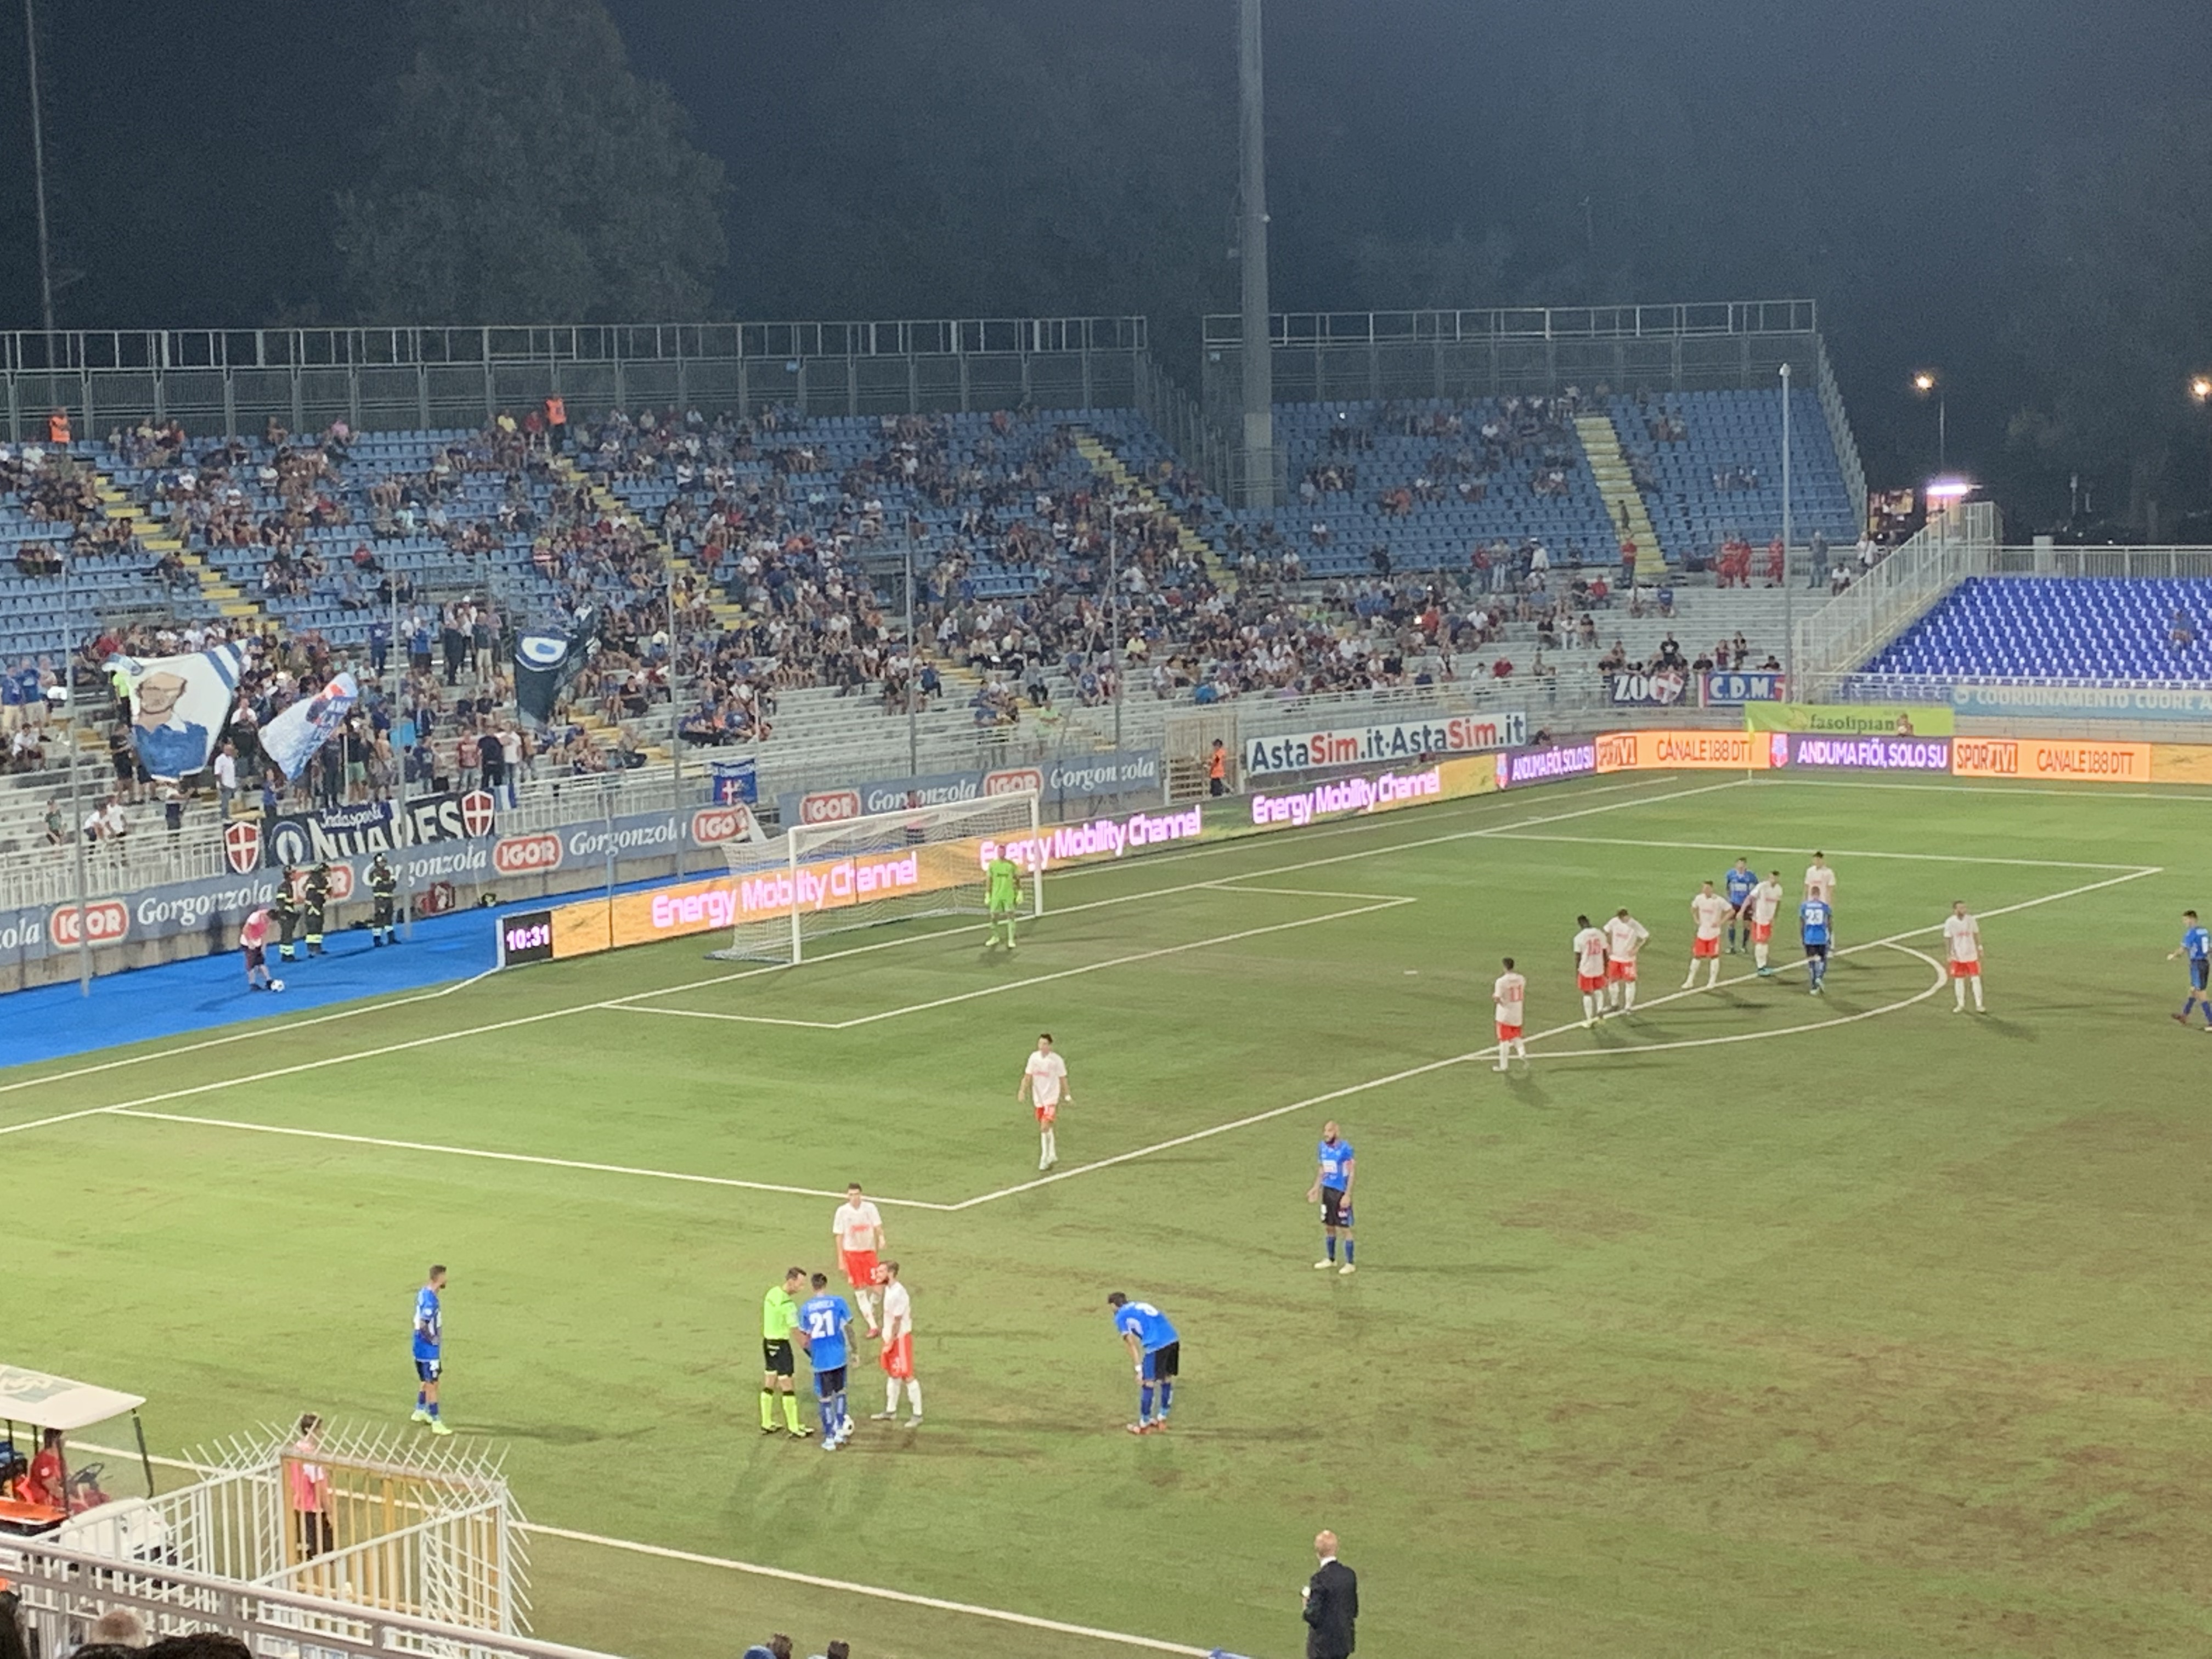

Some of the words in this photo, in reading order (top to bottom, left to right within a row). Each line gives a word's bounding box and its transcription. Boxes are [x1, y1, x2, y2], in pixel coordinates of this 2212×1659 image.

[1976, 689, 2129, 709] COORDINAMENTO
[2135, 692, 2193, 710] CUORE
[1657, 739, 1707, 761] CANALE
[1708, 740, 1729, 761] 188
[1797, 741, 1857, 765] ANDUMA
[1888, 743, 1926, 767] SOLO
[1927, 744, 1947, 768] SU
[2036, 749, 2086, 772] CANALE
[2087, 751, 2108, 774] 188
[2111, 752, 2134, 775] DTT
[990, 776, 1037, 795] IGOR
[1252, 792, 1313, 826] Energy
[1316, 778, 1378, 814] Mobility
[1378, 765, 1441, 802] Channel
[806, 797, 853, 822] IGOR
[868, 779, 977, 811] Goronzola
[1054, 820, 1126, 858] Mobility
[1128, 804, 1201, 846] Channel
[501, 842, 556, 866] IGOR
[651, 888, 737, 927] Energy
[831, 851, 918, 896] Channel
[0, 918, 40, 949] ola
[59, 909, 121, 939] IGOR
[138, 879, 273, 926] Gorgonzola
[1805, 909, 1823, 925] 23
[506, 924, 549, 951] 10:31
[809, 1309, 835, 1339] 21
